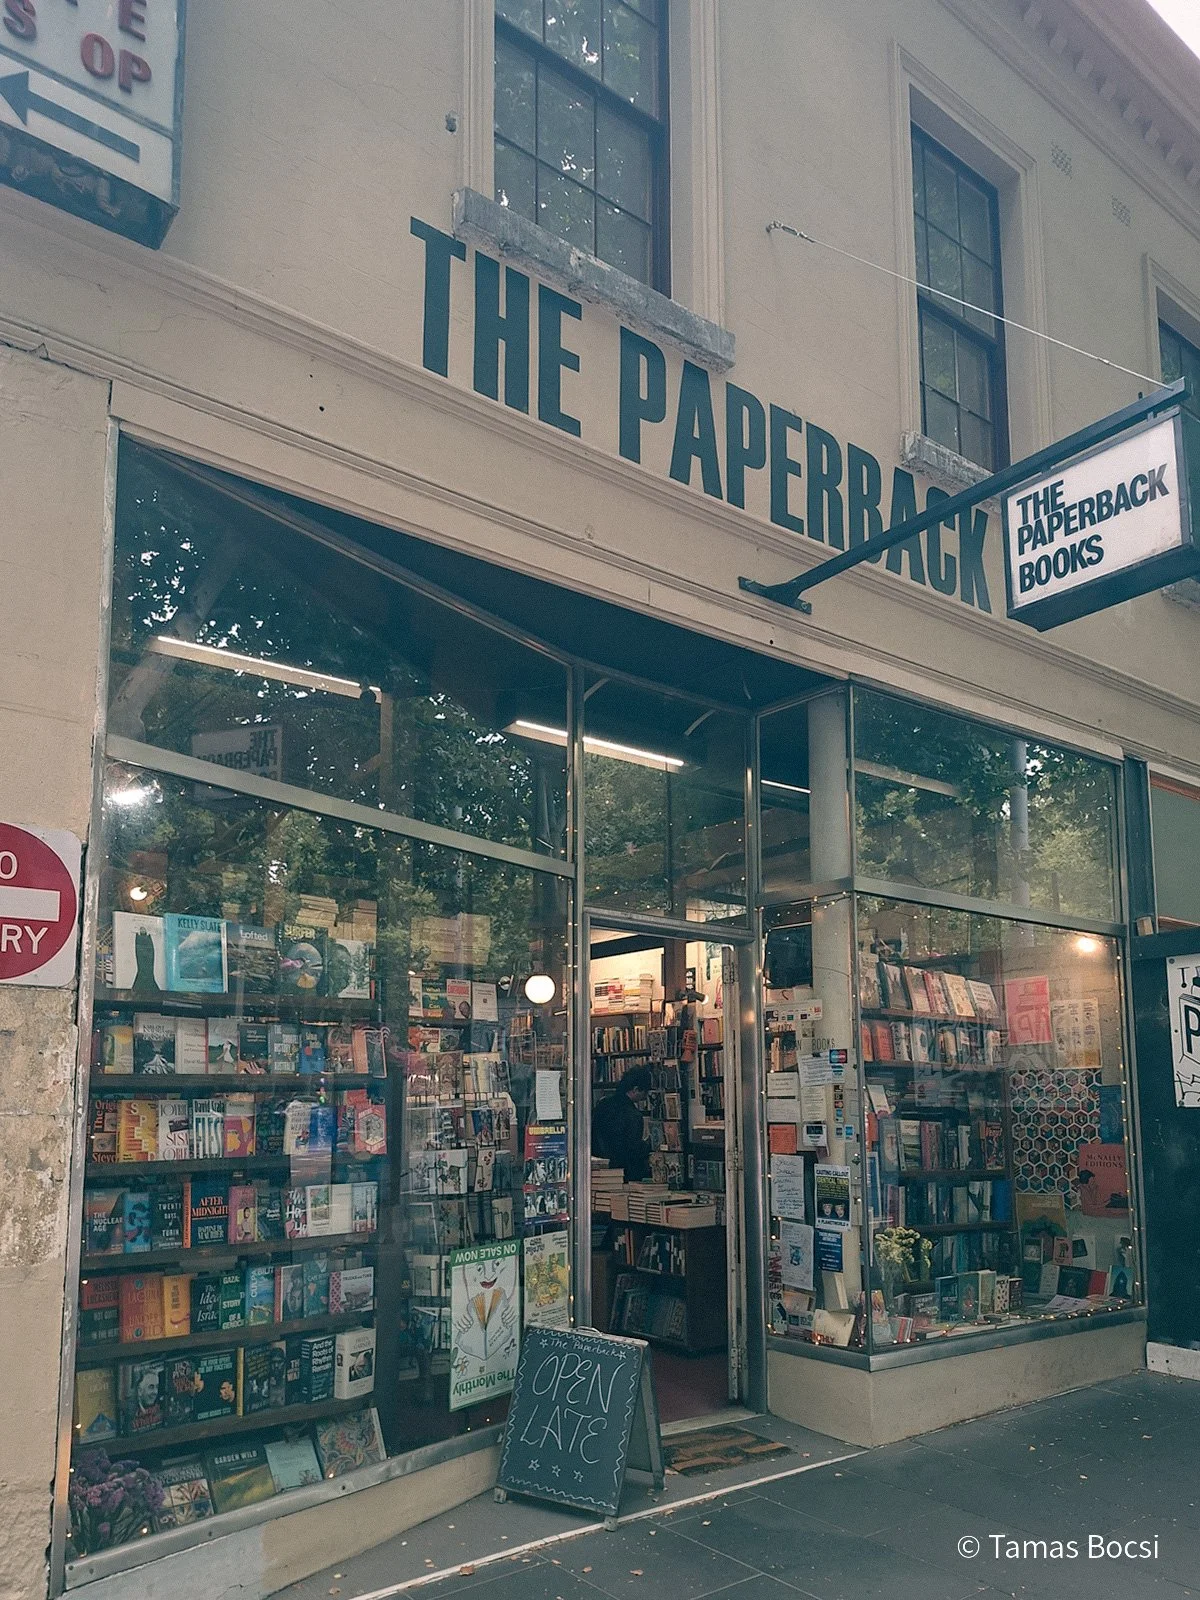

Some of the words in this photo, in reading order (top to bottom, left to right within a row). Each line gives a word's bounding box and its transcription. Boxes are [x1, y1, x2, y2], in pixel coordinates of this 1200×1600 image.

[410, 216, 582, 438] THE
[619, 326, 992, 613] PAPERBACK
[1016, 479, 1065, 525] THE
[1018, 464, 1169, 556] PAPERBACK
[1019, 534, 1104, 593] BOOKS
[178, 918, 200, 930] KELLY
[239, 929, 268, 942] Lofted
[529, 1126, 566, 1135] UMBRELLA
[199, 1196, 223, 1207] AFTER
[93, 1224, 107, 1233] AGE
[480, 1246, 502, 1259] SALE
[503, 1243, 517, 1255] ON
[455, 1249, 478, 1263] NOW
[223, 1299, 241, 1310] STORY
[312, 1341, 324, 1350] And
[548, 1338, 568, 1349] The
[497, 1368, 515, 1381] The
[453, 1372, 496, 1397] Monthly
[533, 1352, 626, 1414] OPEN
[520, 1405, 608, 1464] LATE
